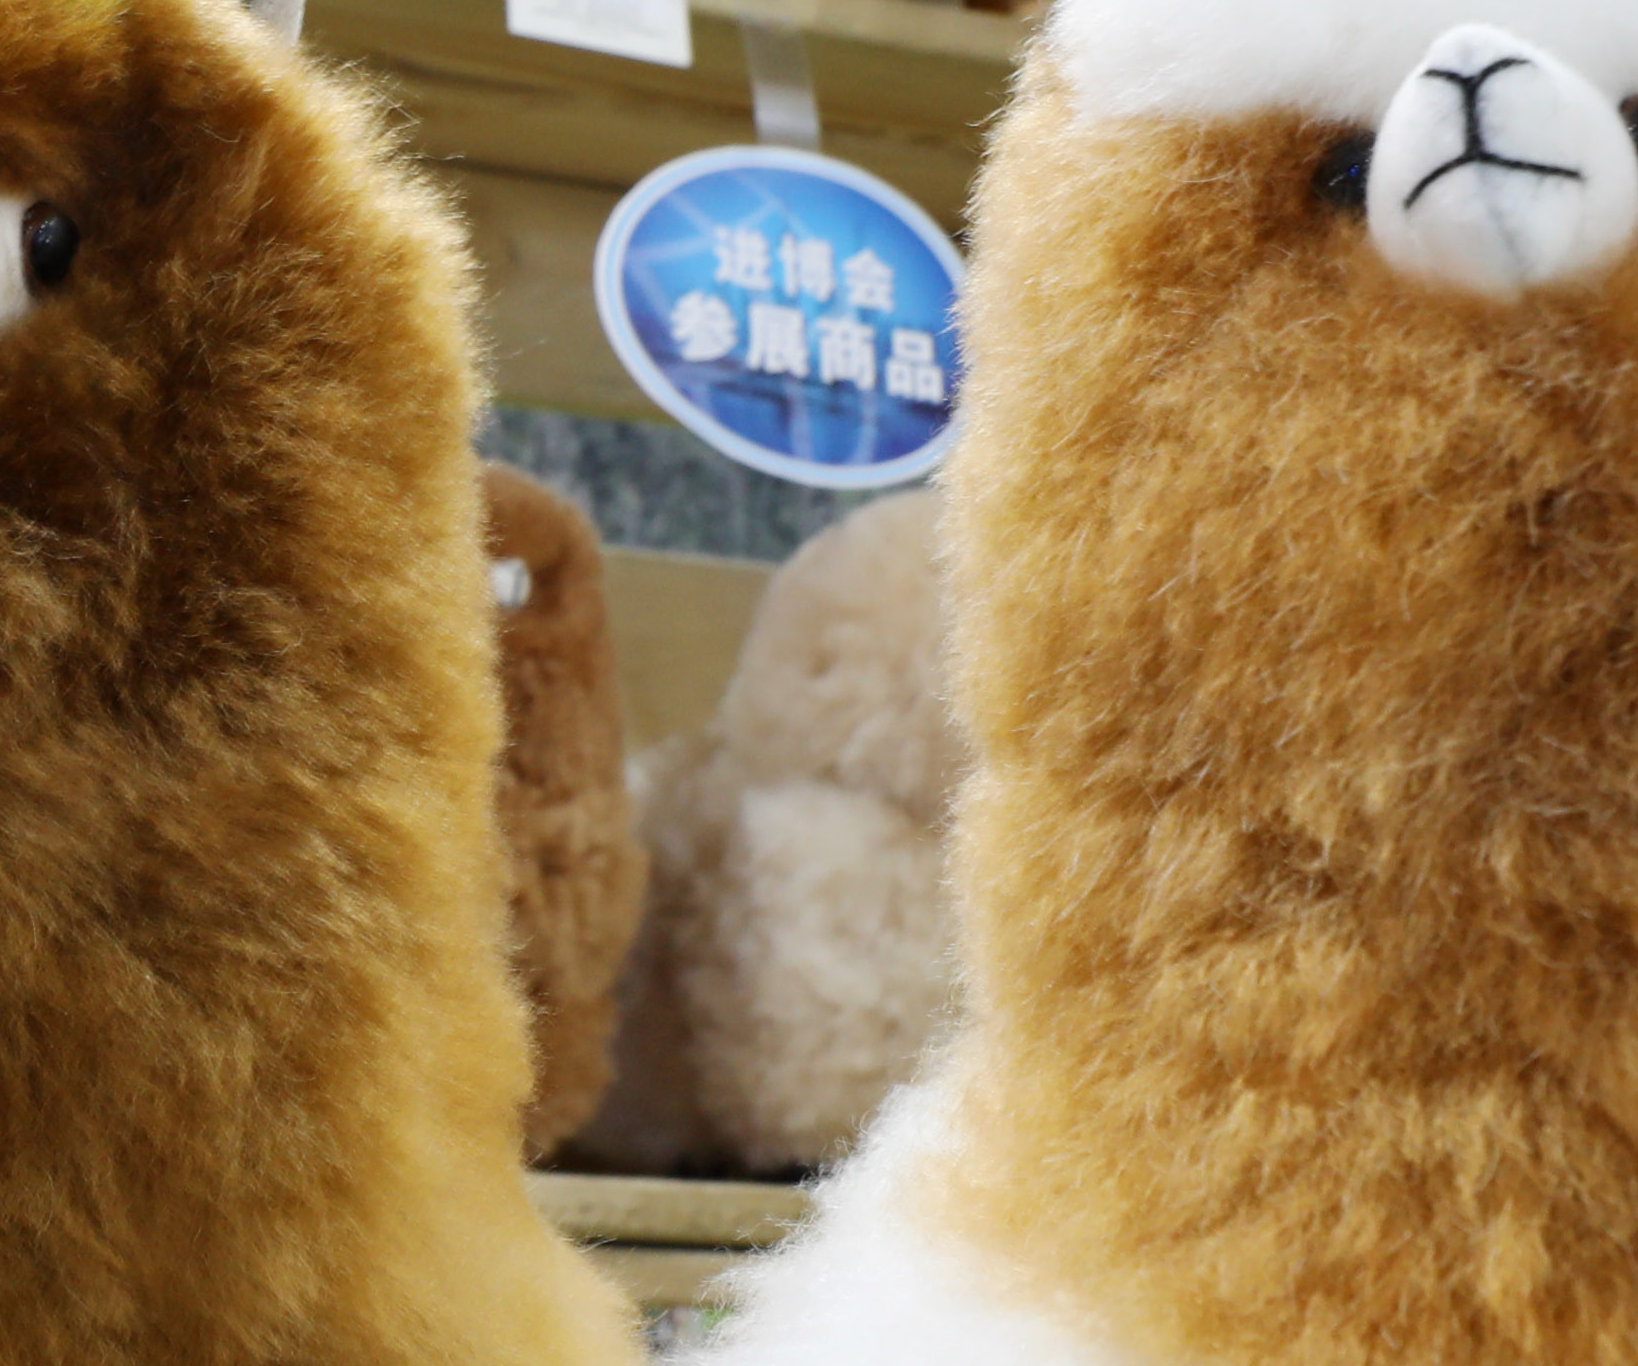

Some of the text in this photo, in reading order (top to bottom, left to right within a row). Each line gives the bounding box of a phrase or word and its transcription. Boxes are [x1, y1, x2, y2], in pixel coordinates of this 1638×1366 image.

[714, 225, 897, 315] 进博会
[670, 290, 947, 404] 参展商品
